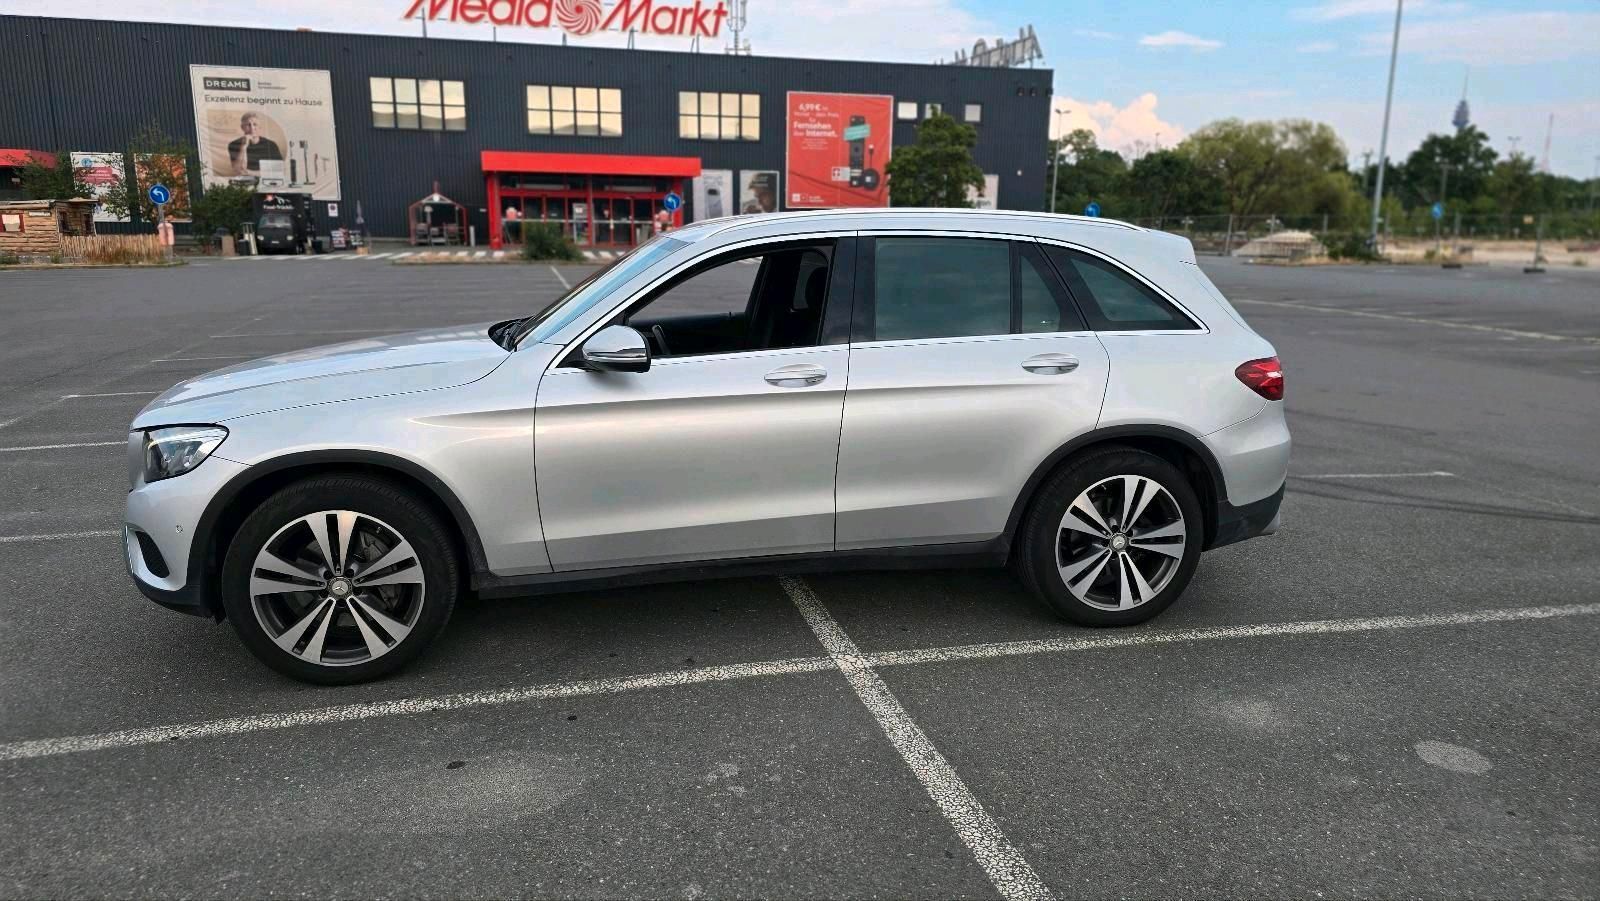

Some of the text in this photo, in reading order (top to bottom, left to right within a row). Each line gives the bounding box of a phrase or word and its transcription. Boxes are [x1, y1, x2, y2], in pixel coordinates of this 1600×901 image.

[600, 0, 728, 37] Markt
[206, 79, 248, 89] DREAME
[204, 95, 245, 104] Exzellenz
[247, 96, 281, 106] beginnt
[295, 98, 323, 106] Hause
